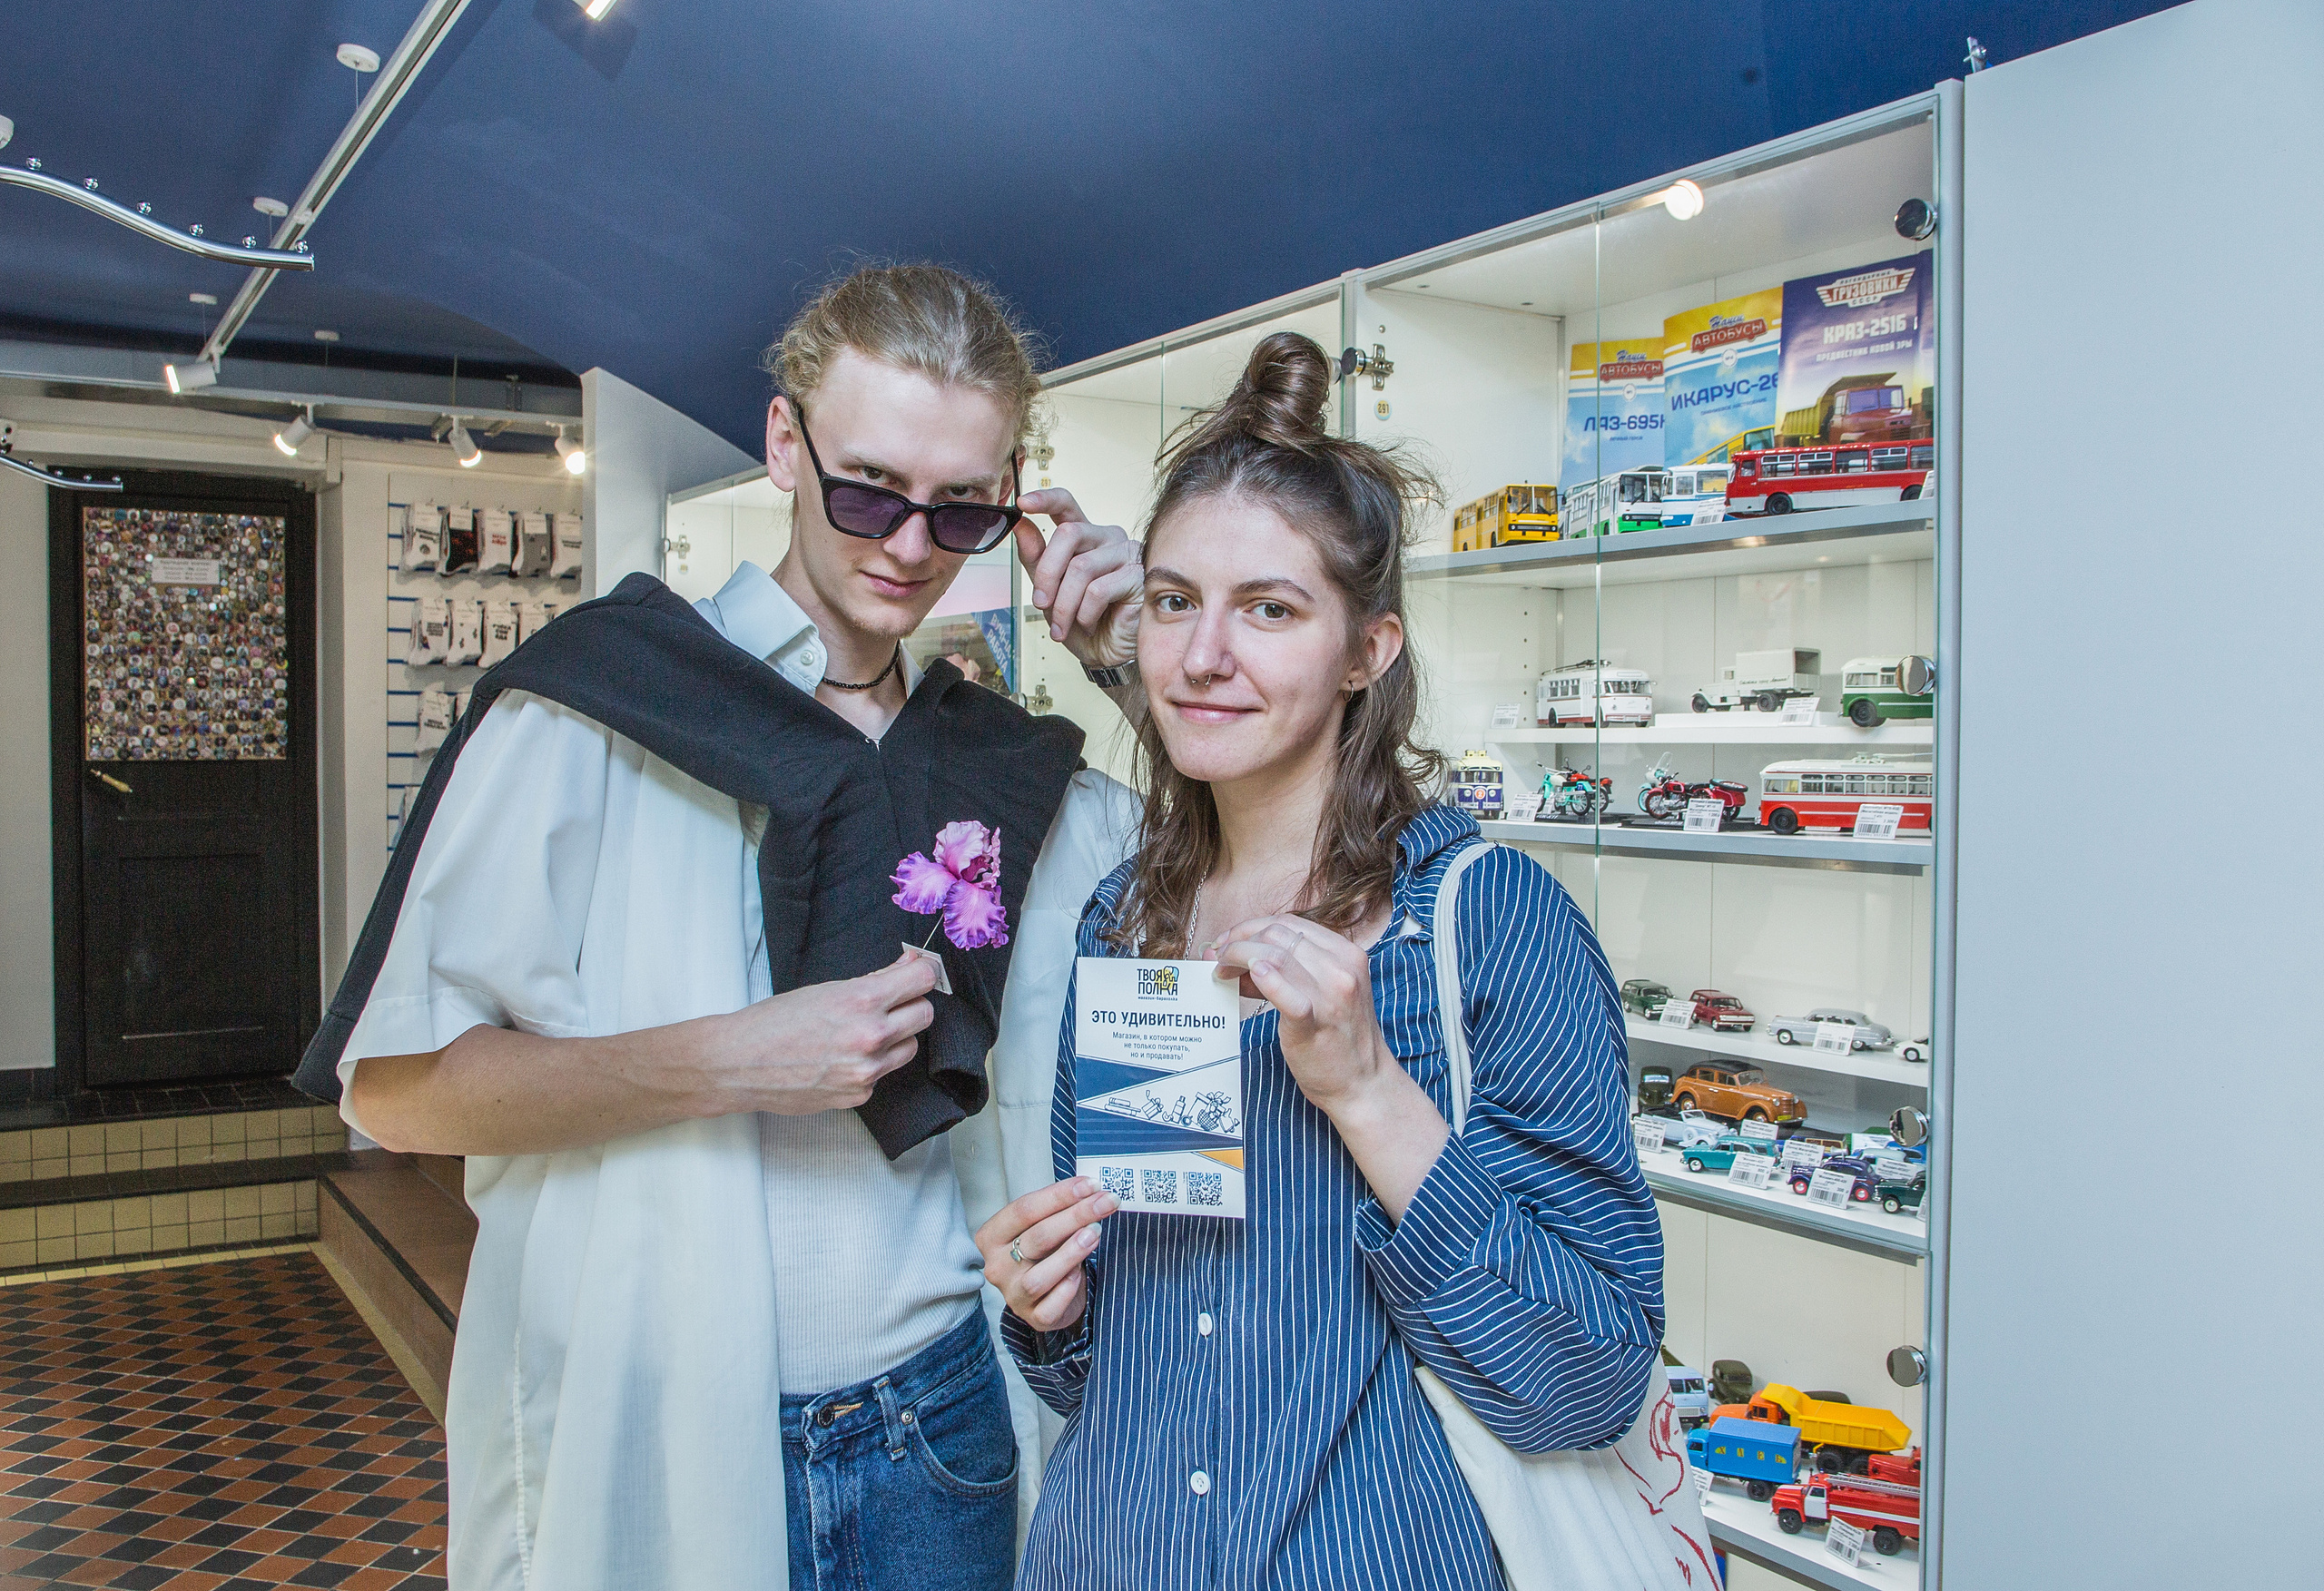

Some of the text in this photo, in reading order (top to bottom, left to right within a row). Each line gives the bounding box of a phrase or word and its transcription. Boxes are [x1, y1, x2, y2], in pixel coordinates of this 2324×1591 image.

[1832, 276, 1898, 301] ГРУЗОВИКИ
[1852, 296, 1878, 306] СССР
[1709, 315, 1744, 328] Наши
[1694, 322, 1763, 347] АВТОБУСЫ
[1823, 313, 1906, 345] КРАЗ-251Б
[1616, 349, 1647, 361] Наши
[1601, 364, 1661, 377] АВТОБУСЫ
[987, 628, 1009, 673] РАБОТА
[1137, 968, 1163, 982] ТВОЯ
[1137, 982, 1178, 996] ПОЛКА
[1091, 1010, 1226, 1029] ЭТО УДИВИТЕЛЬНО!
[1112, 1031, 1142, 1041] Магазин,
[1157, 1045, 1191, 1053] покупать,
[1146, 1053, 1184, 1061] продавать!
